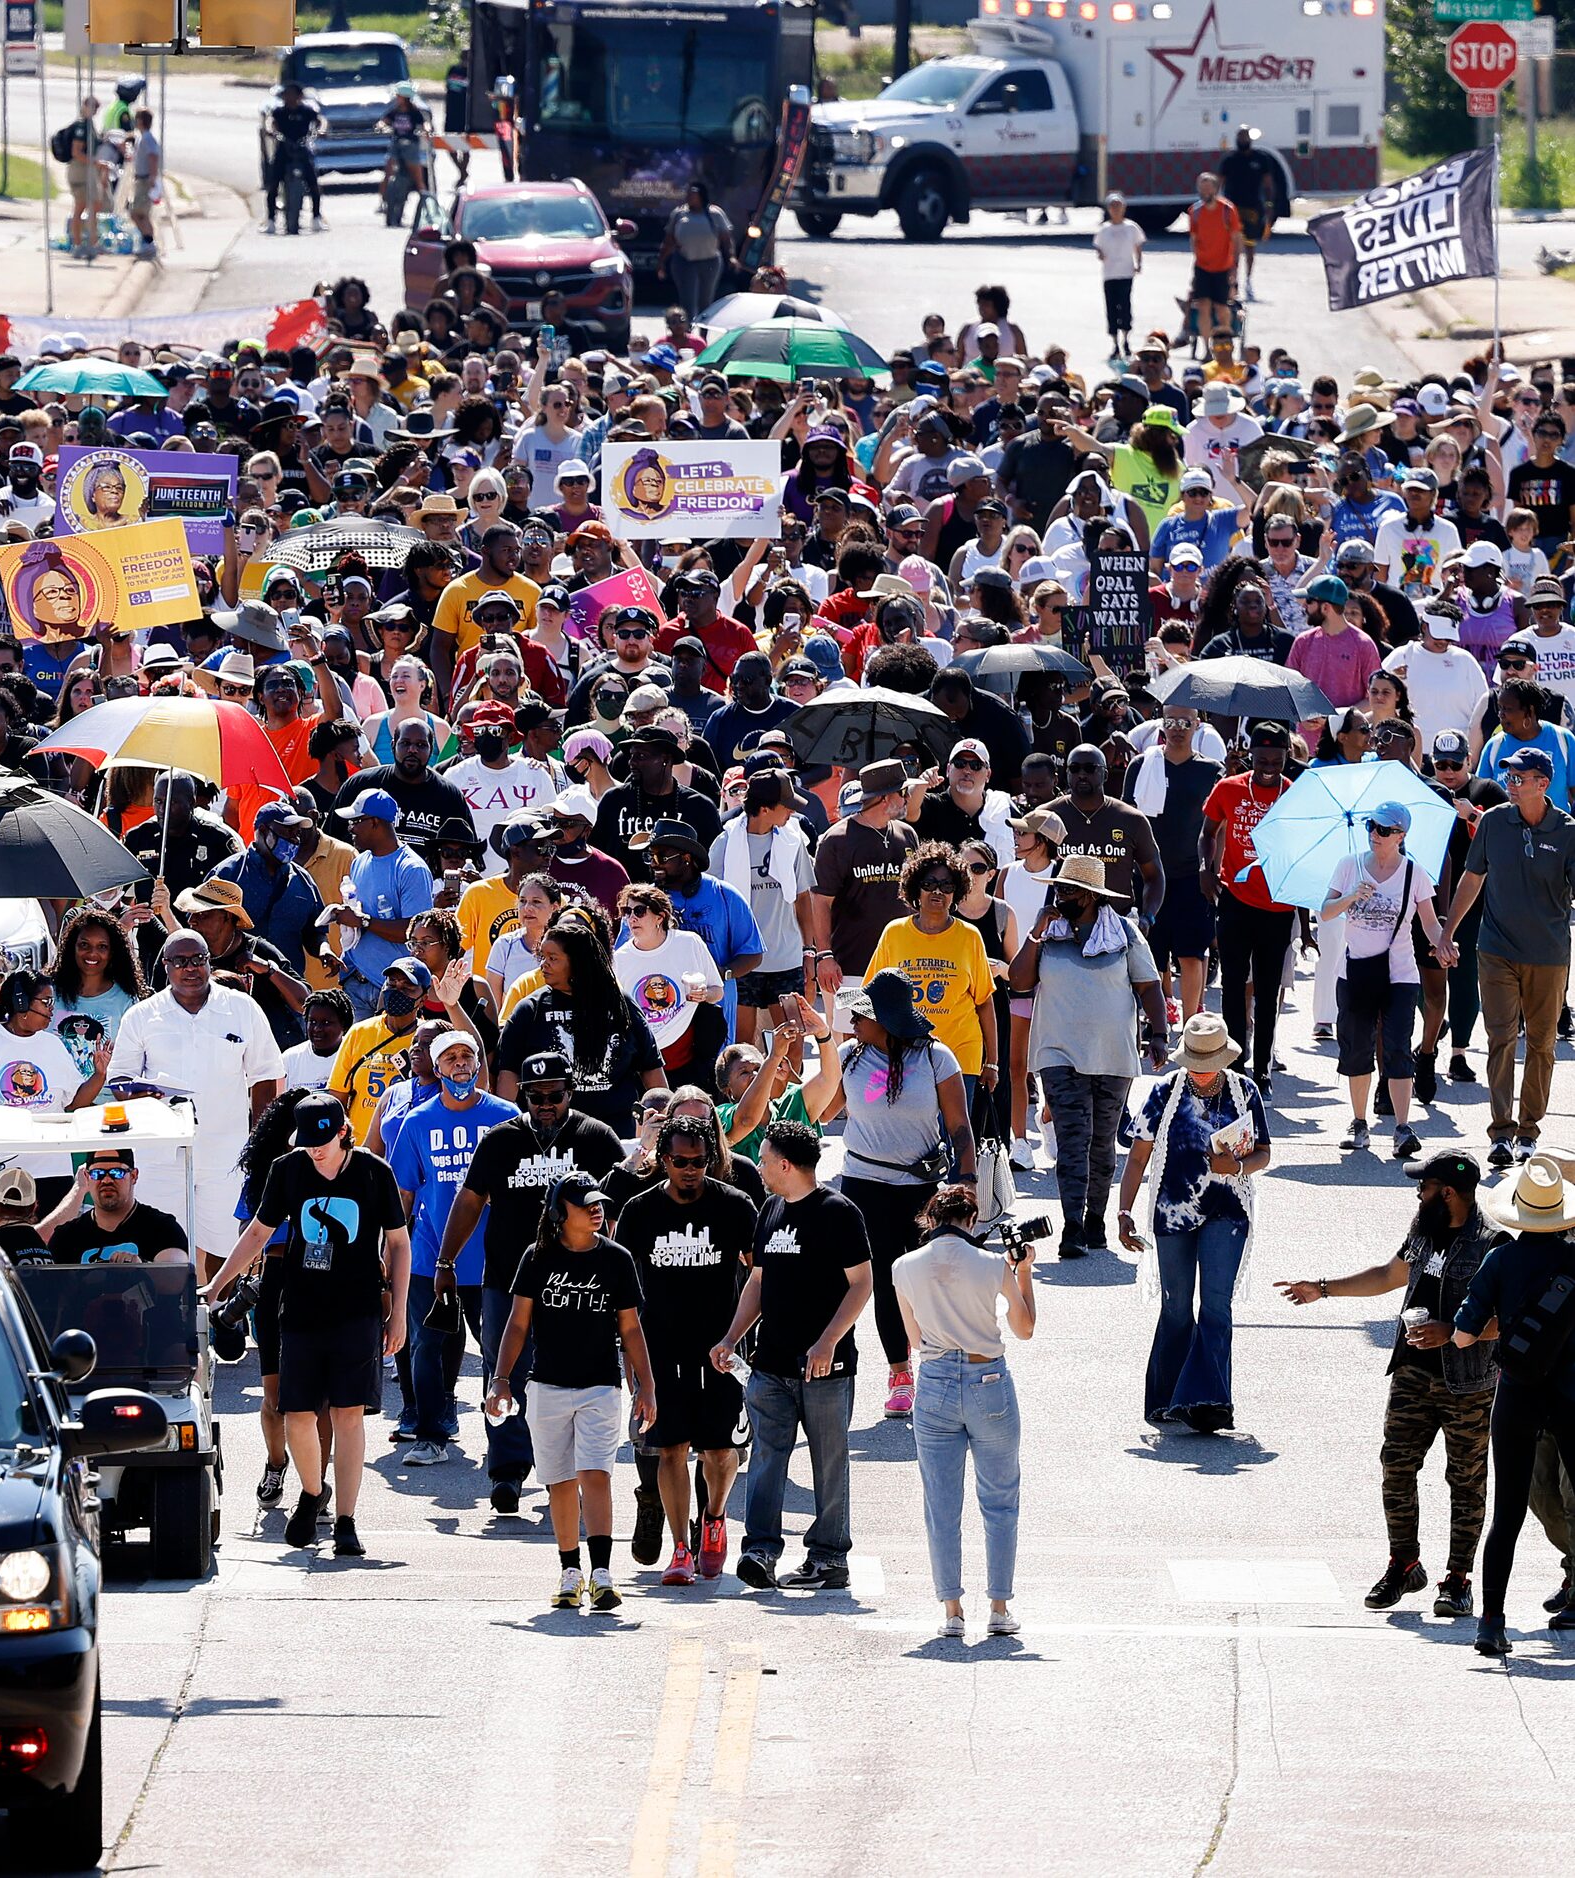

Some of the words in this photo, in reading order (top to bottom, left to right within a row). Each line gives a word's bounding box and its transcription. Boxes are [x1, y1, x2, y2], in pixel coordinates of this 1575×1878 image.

[1436, 1, 1503, 17] Missouri
[1453, 42, 1515, 70] STOP
[674, 479, 765, 493] CELEBRATE
[155, 488, 221, 501] JUNETEENTH
[677, 497, 754, 509] FREEDOM
[122, 556, 183, 574] FREEDOM
[1099, 556, 1146, 572] WHEN
[1096, 575, 1135, 592] OPAL
[1101, 594, 1139, 609] SAYS
[1093, 610, 1140, 626] WALK
[406, 810, 440, 828] AACE
[1057, 844, 1085, 856] nited
[1087, 843, 1101, 856] As
[1105, 845, 1126, 857] One
[853, 863, 885, 879] United
[887, 862, 900, 875] As
[915, 957, 957, 969] TERRELL
[448, 1152, 463, 1165] of
[653, 1244, 715, 1257] COMMUNITY
[764, 1245, 802, 1254] FRONTLINE
[305, 1260, 329, 1270] CREW
[546, 1271, 601, 1290] Black
